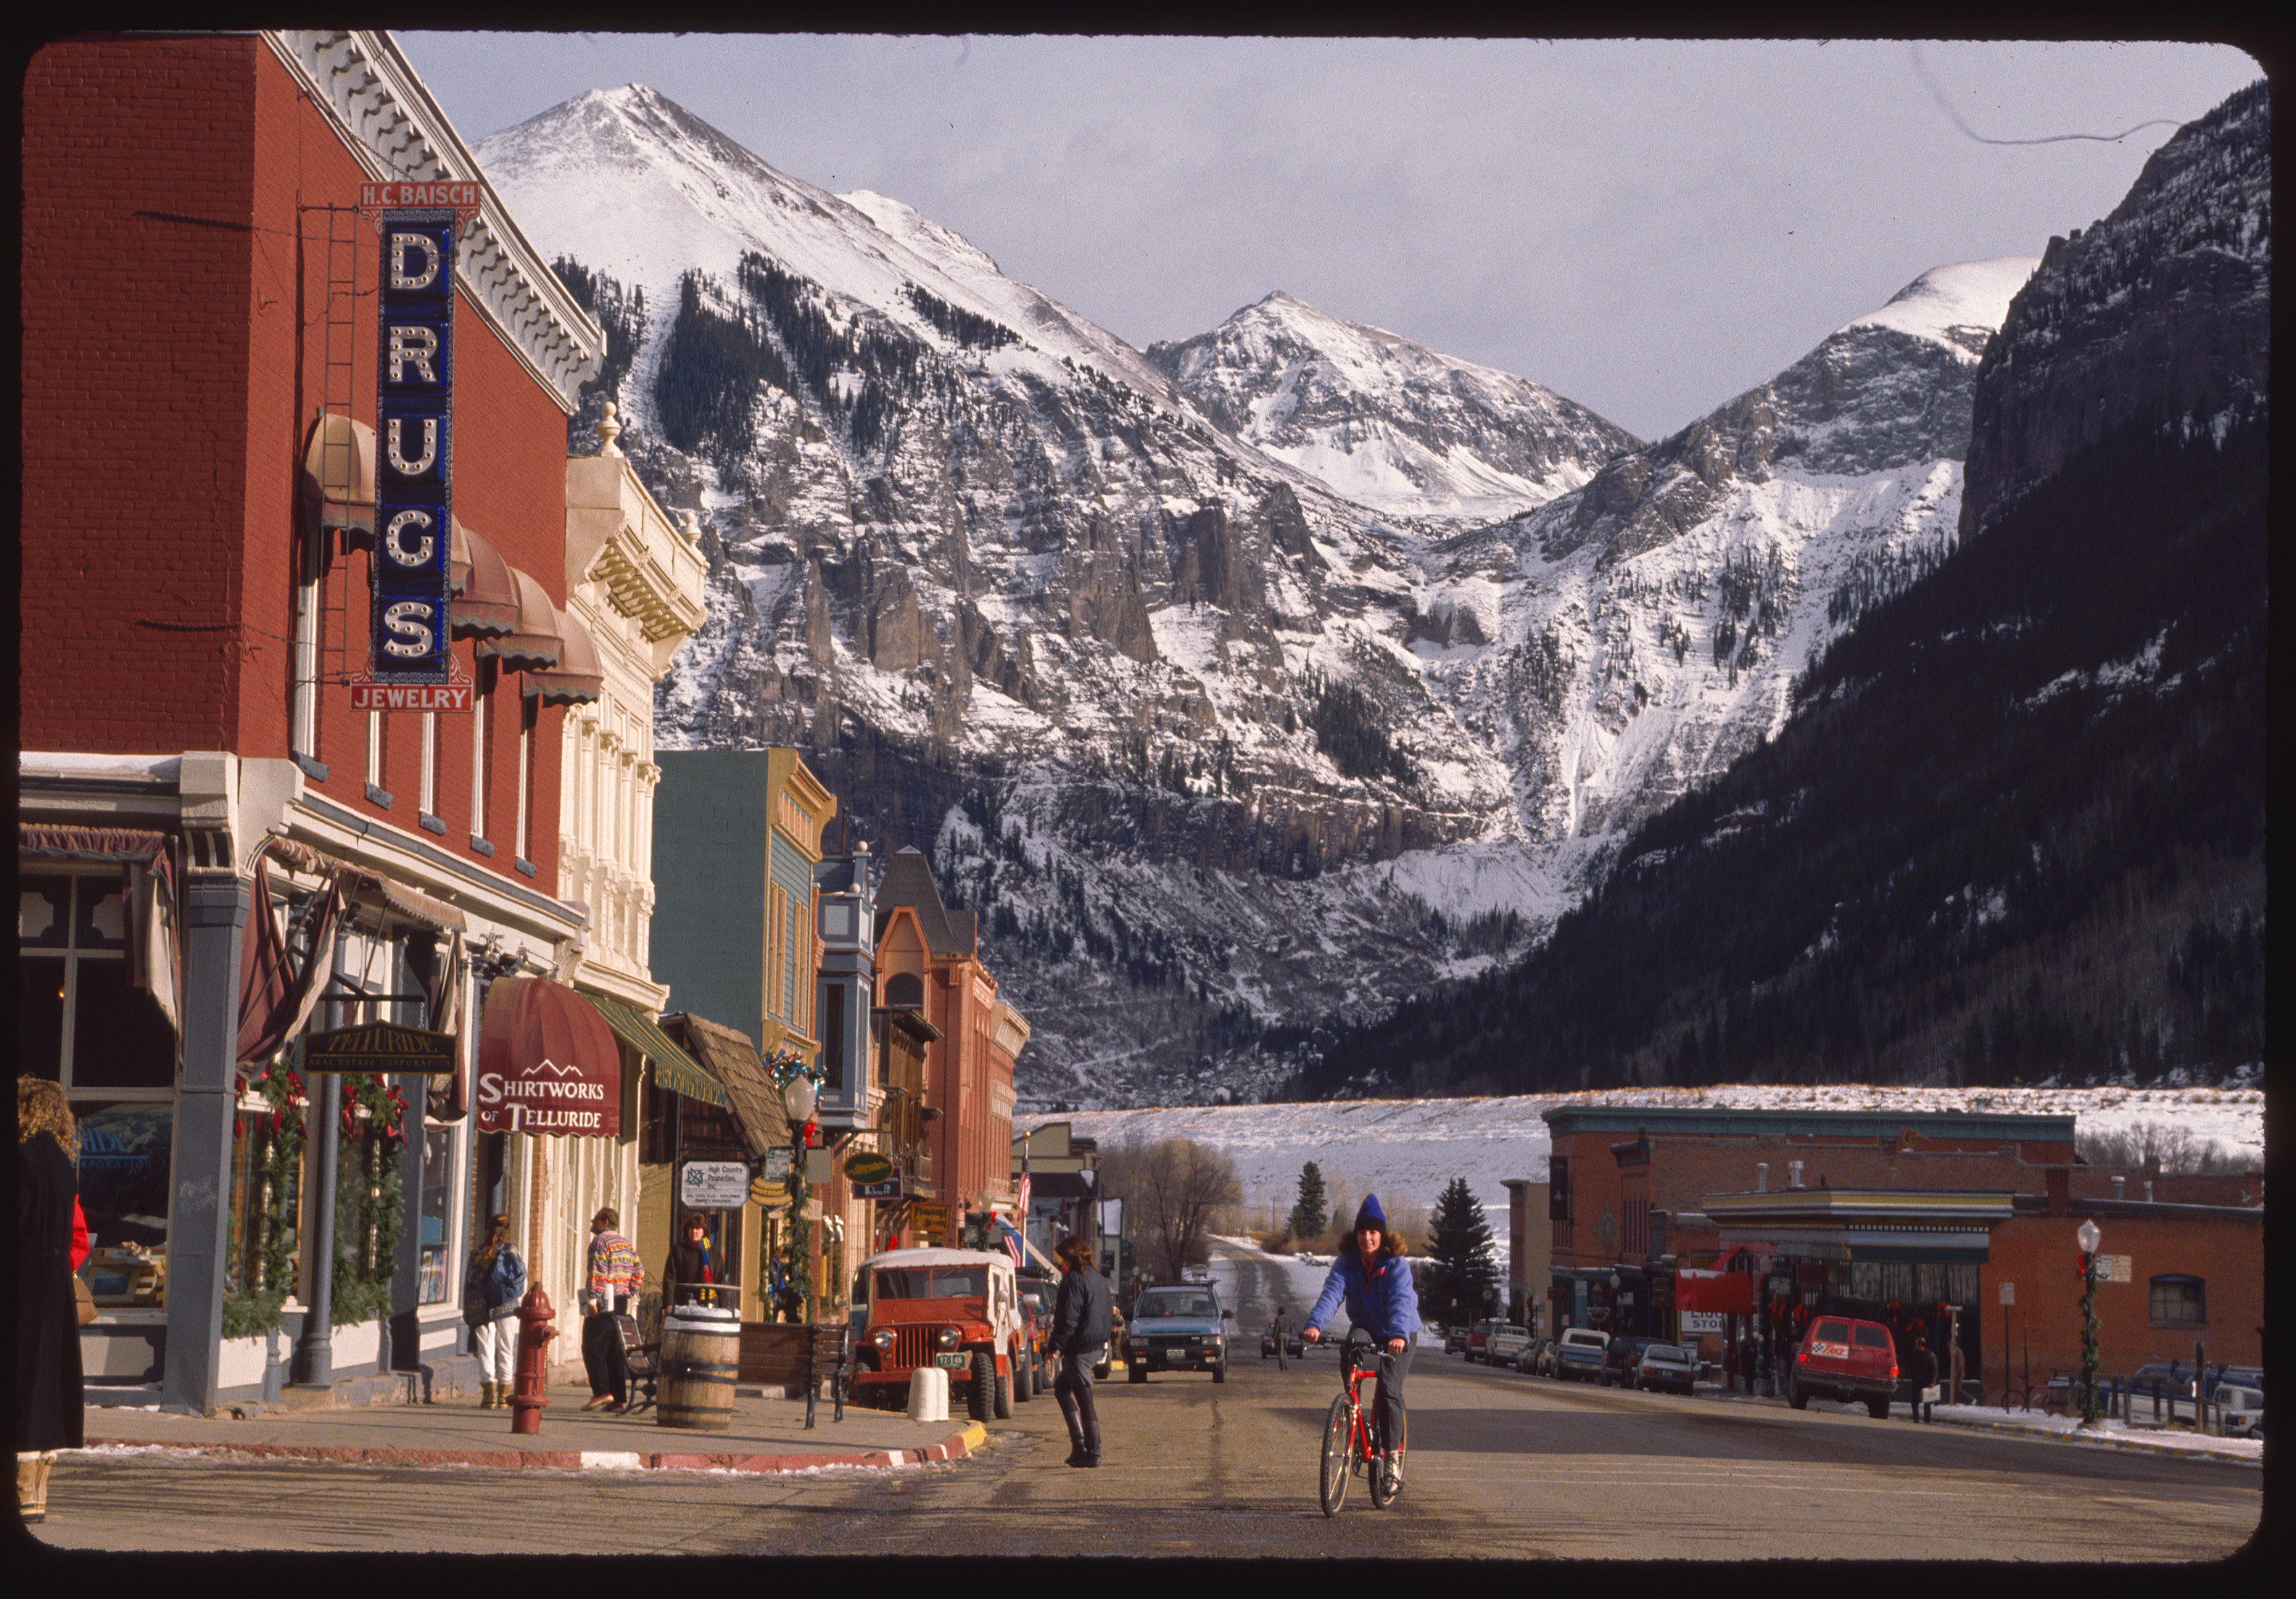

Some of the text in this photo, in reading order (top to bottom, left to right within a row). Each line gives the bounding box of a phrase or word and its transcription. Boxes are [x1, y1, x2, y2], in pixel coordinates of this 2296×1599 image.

[400, 185, 475, 204] BAISCH
[384, 232, 440, 658] DRUGS
[355, 688, 468, 708] JEWELRY
[328, 1028, 439, 1052] TELLURIDE
[479, 1073, 605, 1103] SHIRTWORKS
[505, 1102, 602, 1132] TELLURIDE
[709, 1165, 720, 1174] High
